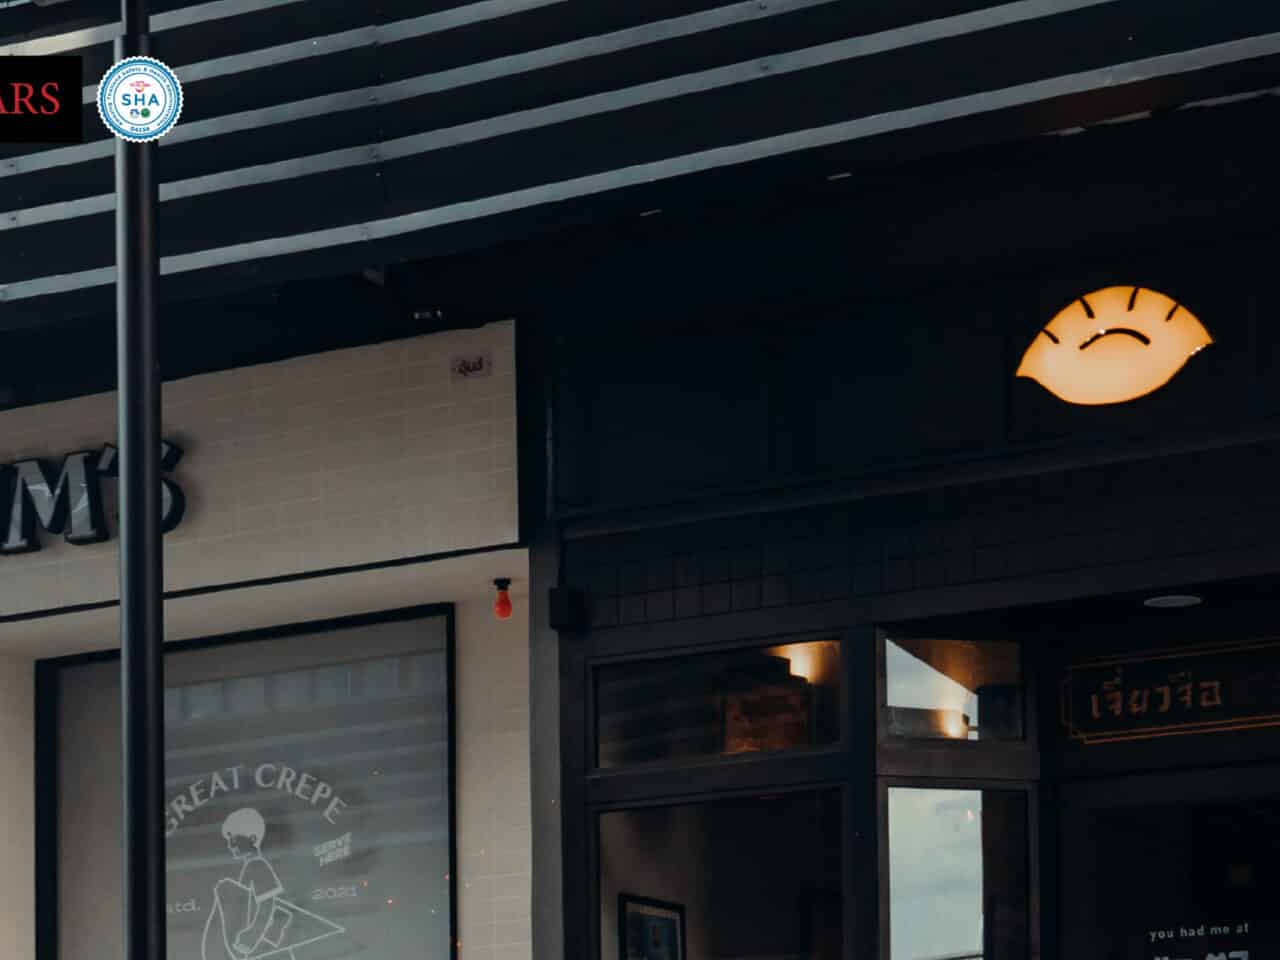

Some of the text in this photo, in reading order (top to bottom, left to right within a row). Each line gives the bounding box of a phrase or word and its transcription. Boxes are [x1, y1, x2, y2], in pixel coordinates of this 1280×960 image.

[255, 763, 348, 825] CREPE
[1149, 928, 1174, 942] you
[1180, 924, 1205, 937] had
[1210, 925, 1230, 936] me
